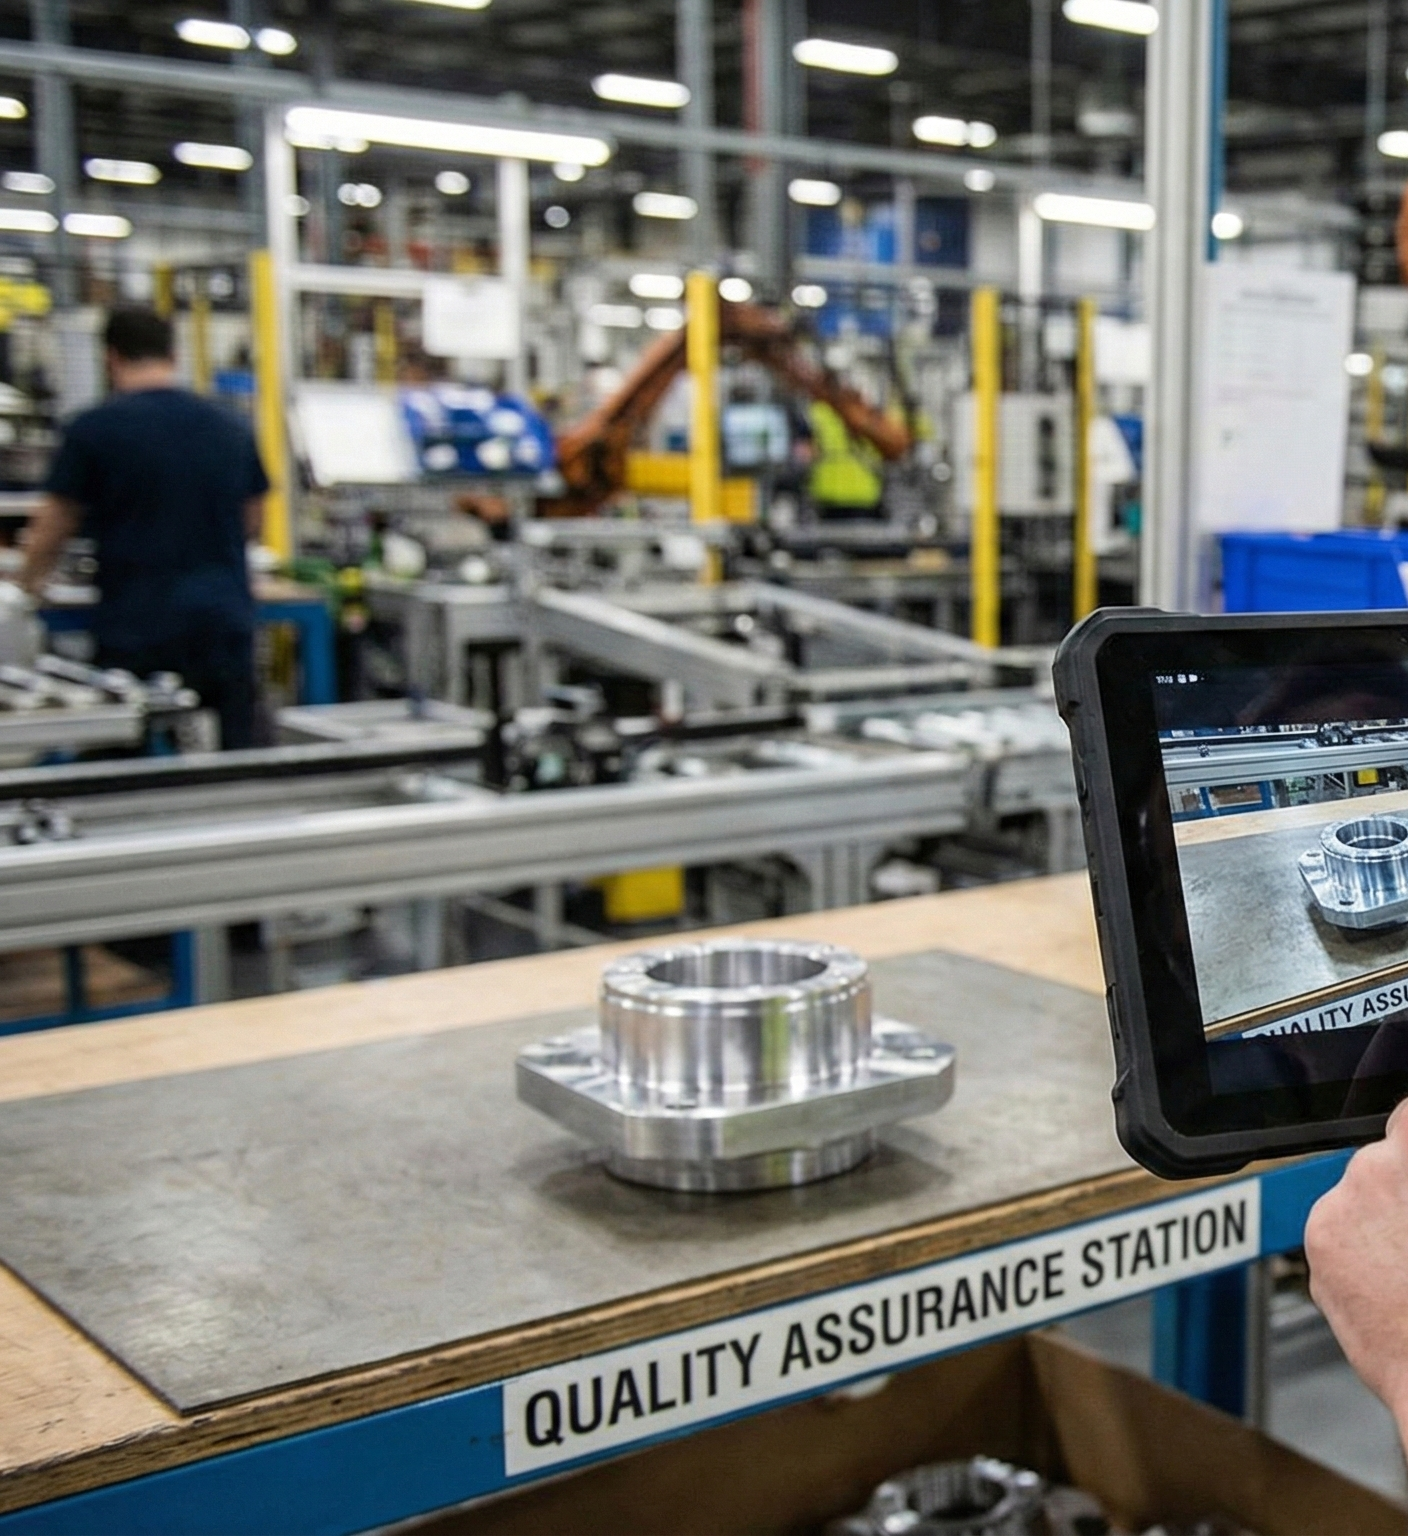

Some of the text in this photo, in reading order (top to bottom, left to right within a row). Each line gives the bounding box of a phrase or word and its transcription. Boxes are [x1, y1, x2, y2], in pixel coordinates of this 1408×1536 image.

[1254, 1003, 1353, 1037] ALITY
[525, 1200, 1246, 1447] QUALITY ASSURANCE STATION
